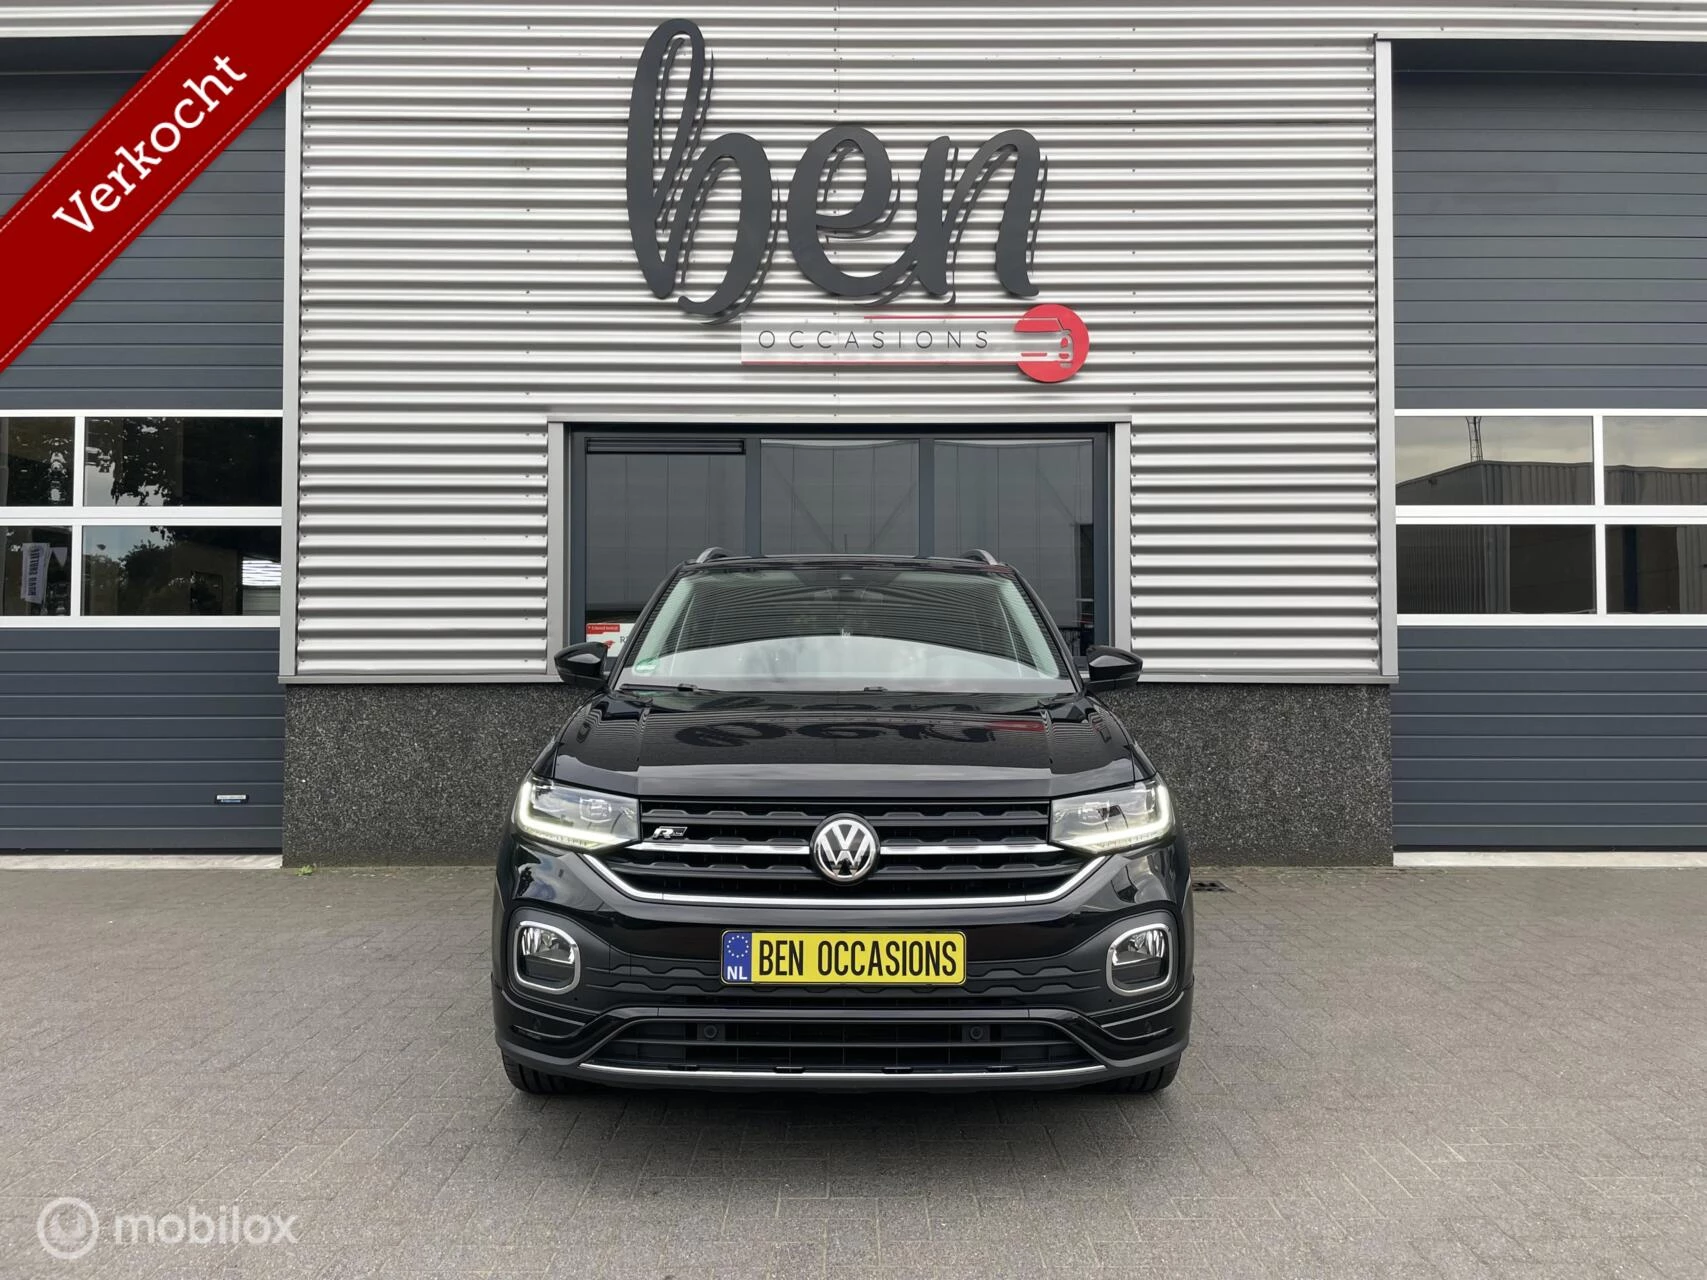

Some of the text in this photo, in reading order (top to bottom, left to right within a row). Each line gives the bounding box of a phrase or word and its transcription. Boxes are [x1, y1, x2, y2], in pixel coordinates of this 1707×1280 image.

[626, 18, 1040, 315] ben
[758, 330, 988, 349] OCCASIONS
[758, 940, 957, 977] BEN OCCASIONS
[727, 966, 748, 981] NL
